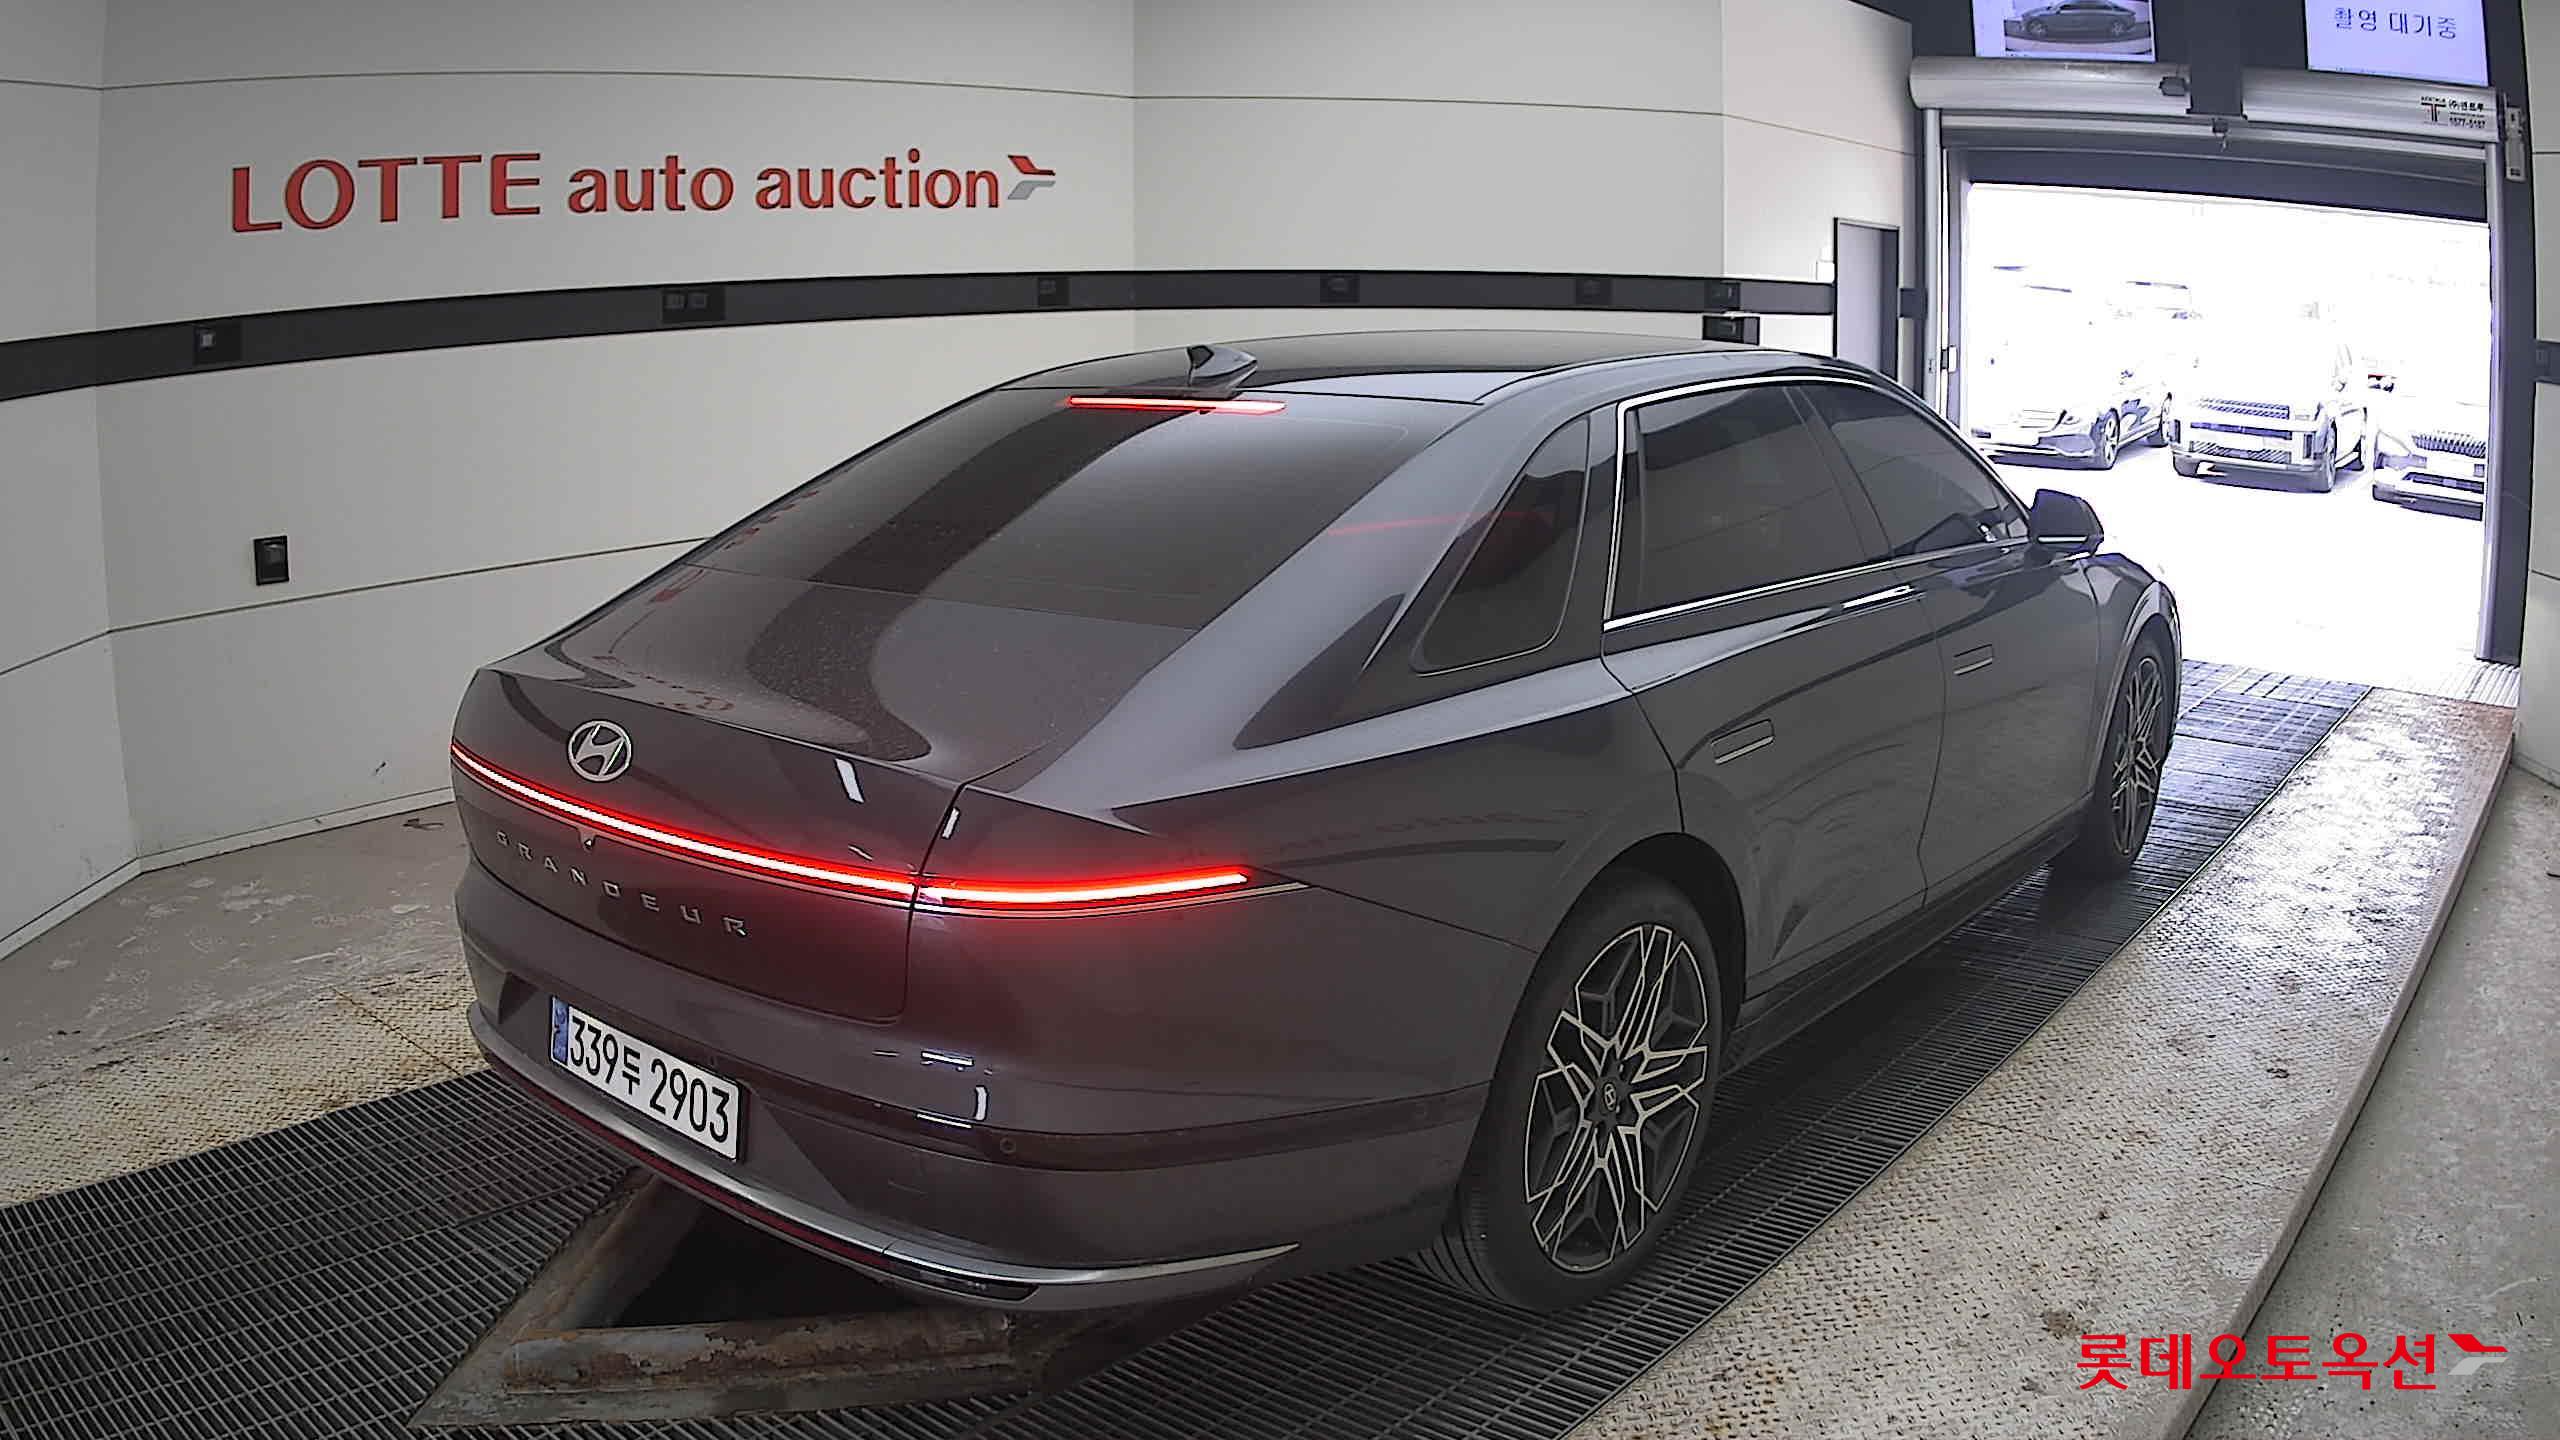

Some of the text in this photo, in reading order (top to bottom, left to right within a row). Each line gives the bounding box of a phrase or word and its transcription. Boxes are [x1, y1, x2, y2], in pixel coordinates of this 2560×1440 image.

[2389, 12, 2457, 40] 대기중
[232, 147, 1001, 233] LOTTE auto auction
[496, 831, 747, 936] GRANDEUR
[570, 1016, 730, 1143] 339두 2903
